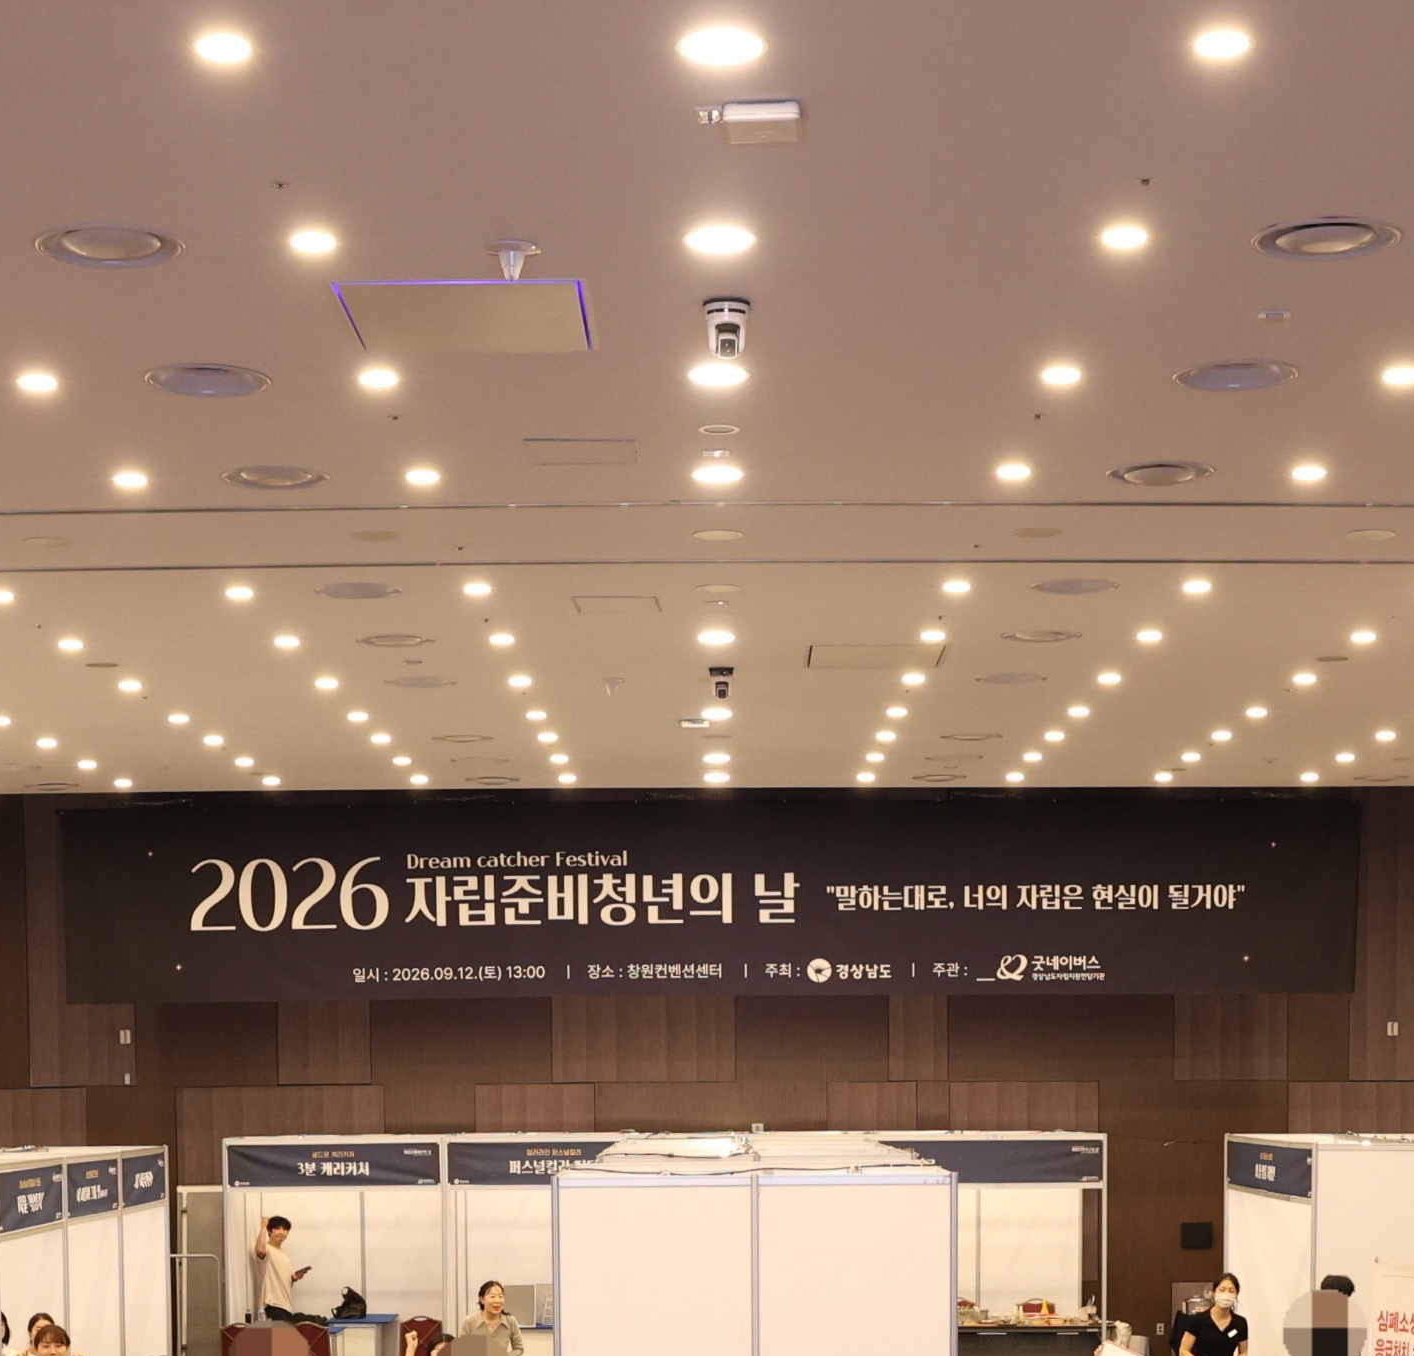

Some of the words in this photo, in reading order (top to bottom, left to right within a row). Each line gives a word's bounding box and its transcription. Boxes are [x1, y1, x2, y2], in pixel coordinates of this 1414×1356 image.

[406, 853, 471, 870] Dream
[476, 851, 550, 868] catcher
[555, 850, 628, 867] Festival
[190, 856, 390, 932] 2026
[405, 871, 733, 927] 자립준비청년의
[754, 872, 801, 924] 날
[826, 884, 955, 911] "말하는대로,
[963, 884, 1008, 911] 너의
[1016, 884, 1084, 910] 자립은
[1091, 883, 1159, 910] 현실이
[1168, 884, 1246, 910] 될거야"
[352, 967, 380, 983] 일시
[392, 965, 502, 982] 2026.09.12.(토)
[506, 965, 546, 979] 13:00
[587, 963, 615, 980] 장소
[627, 962, 722, 979] 창원컨벤션센터
[764, 962, 792, 979] 주최
[835, 963, 892, 980] 경상남도
[932, 961, 960, 978] 주관
[1031, 955, 1101, 972] 굿네이버스
[296, 1162, 317, 1177] 3분
